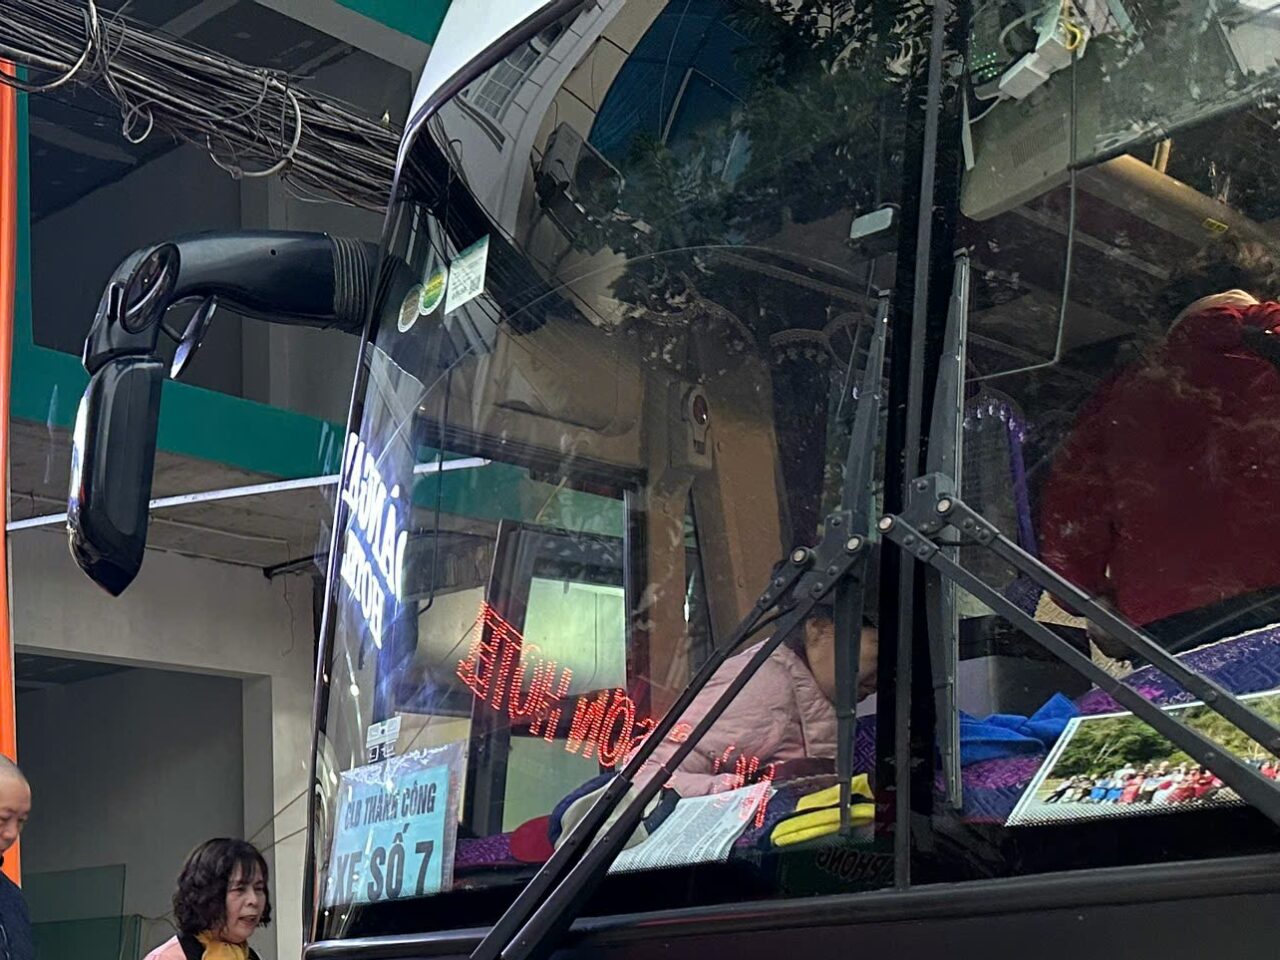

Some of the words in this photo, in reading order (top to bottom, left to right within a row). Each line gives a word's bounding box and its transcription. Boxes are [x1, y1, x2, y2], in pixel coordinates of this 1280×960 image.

[400, 779, 438, 817] CÔNG
[367, 822, 410, 902] SỐ
[414, 839, 435, 897] 7
